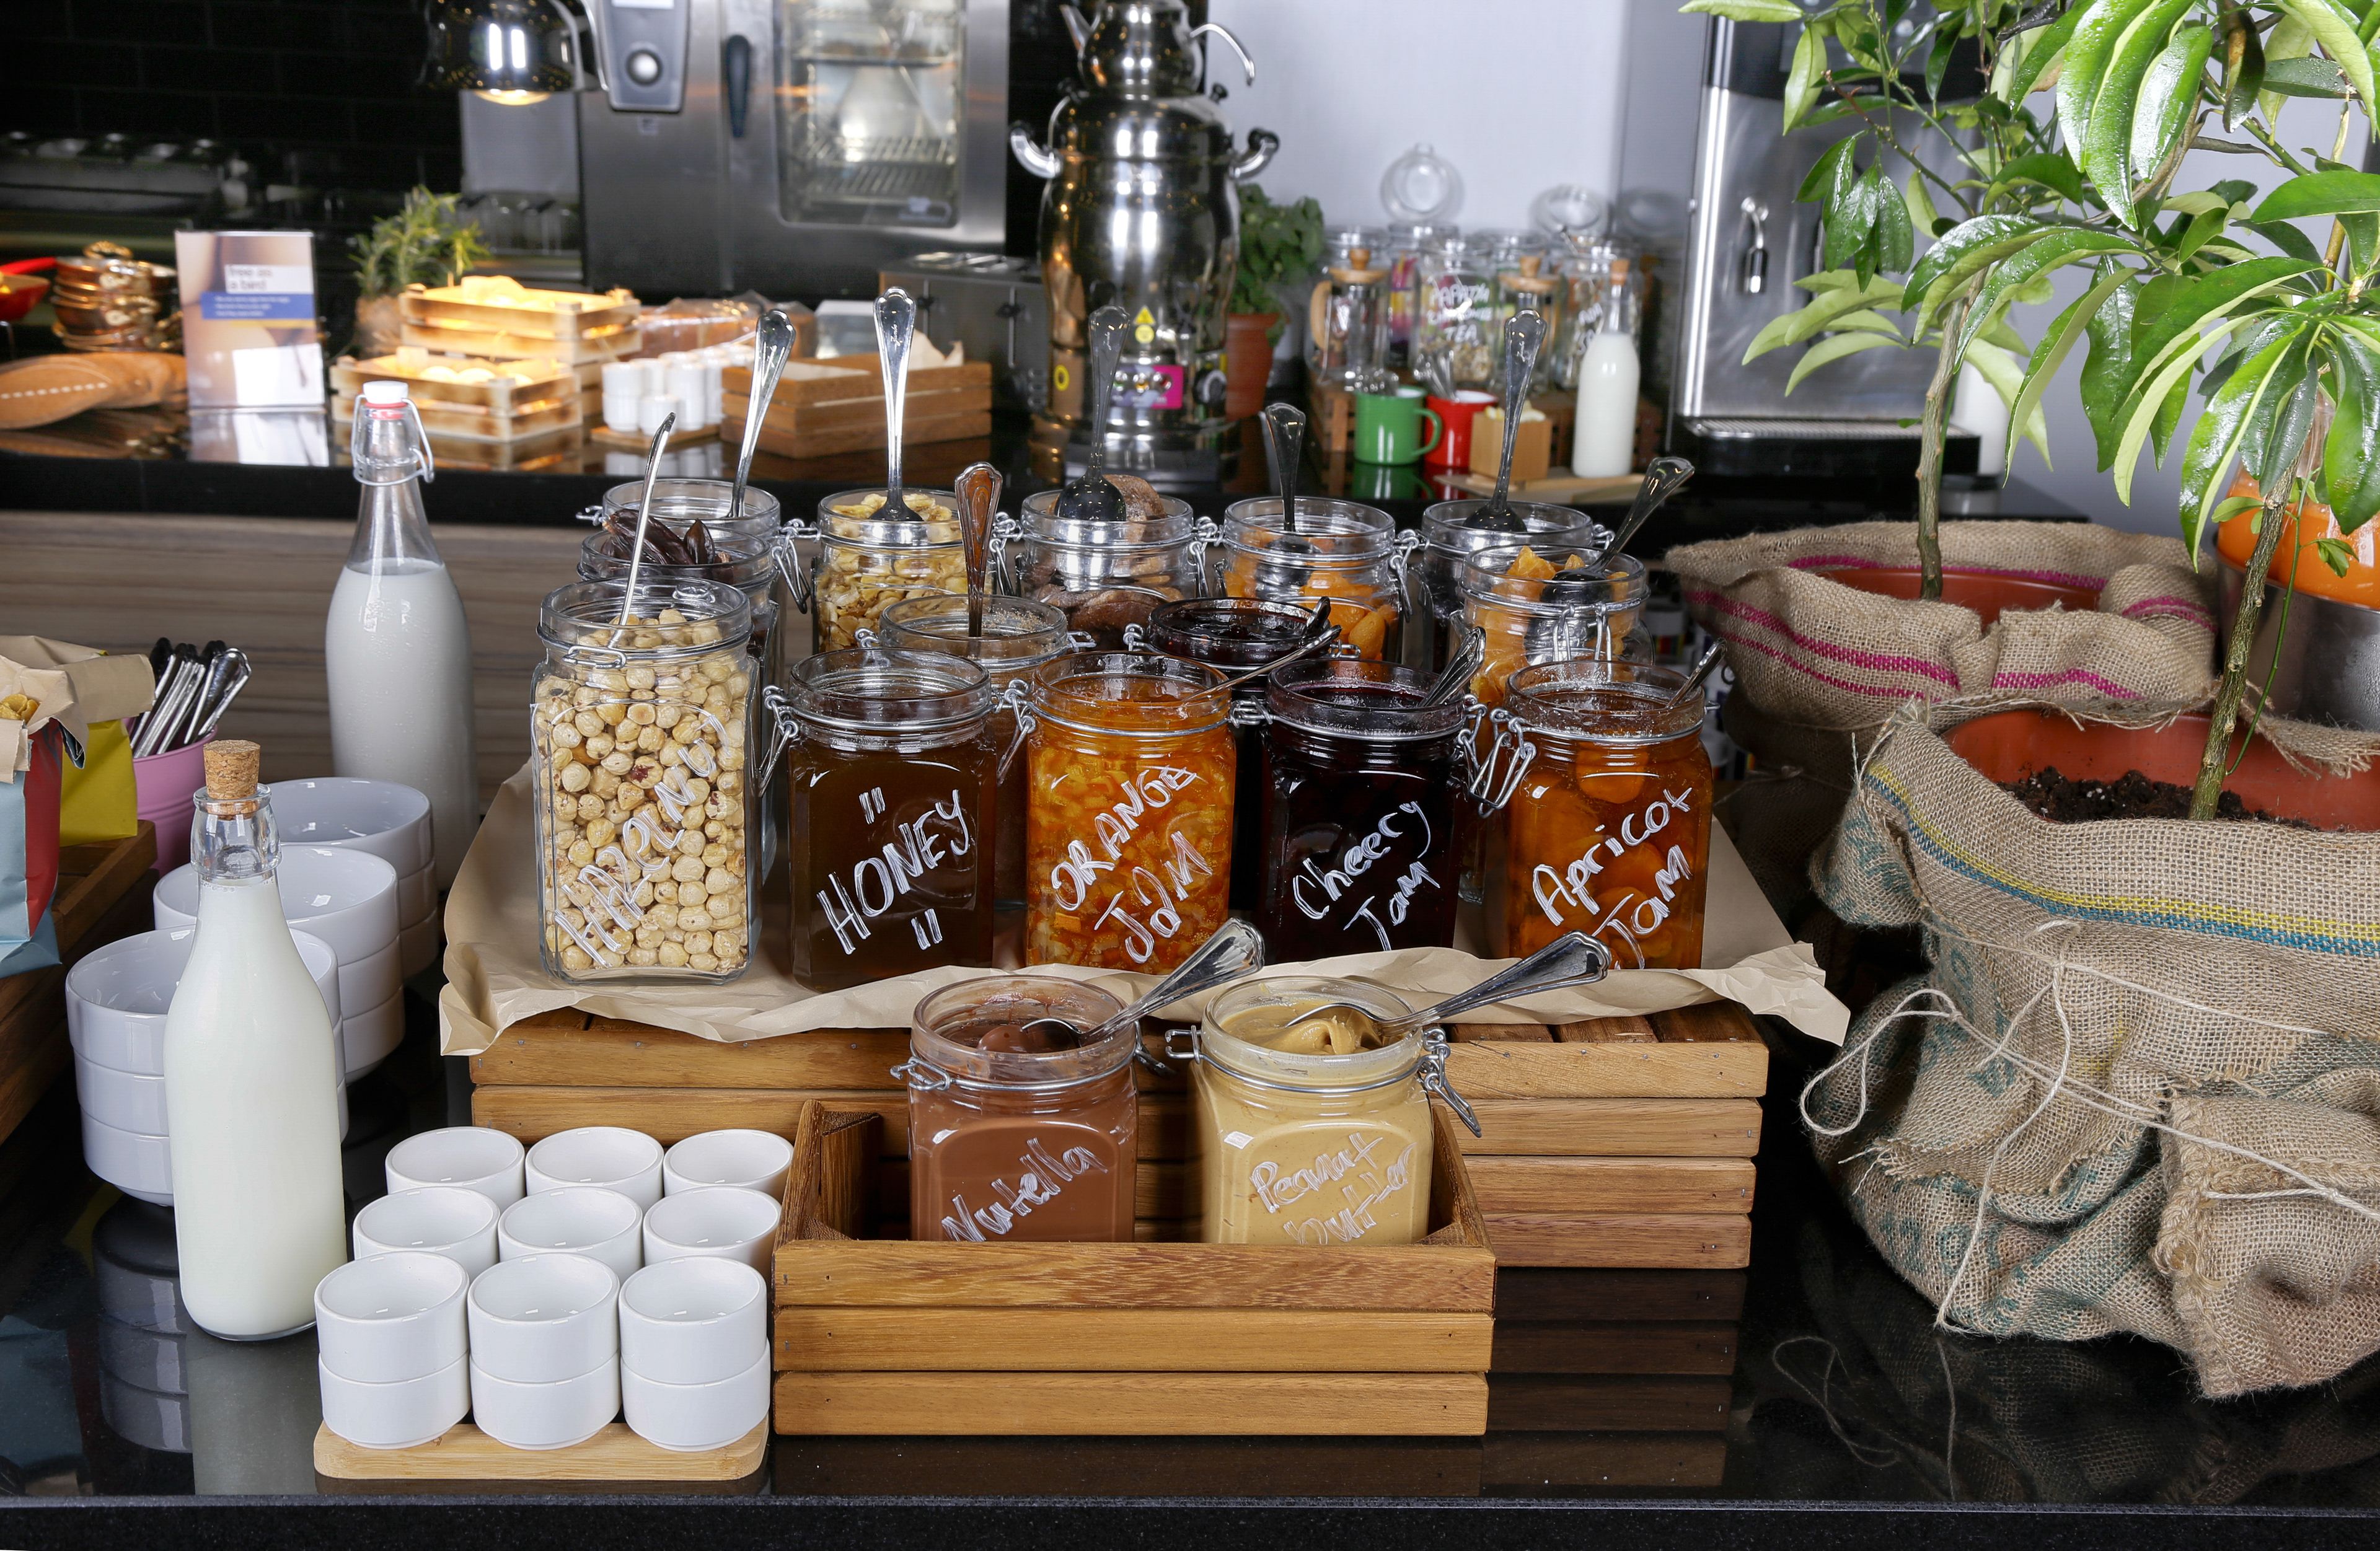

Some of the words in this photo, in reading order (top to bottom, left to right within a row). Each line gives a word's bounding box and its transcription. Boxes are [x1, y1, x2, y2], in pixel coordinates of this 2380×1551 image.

[1443, 324, 1480, 347] TEA
[816, 789, 970, 955] HONEY
[1051, 765, 1200, 911] ORANGE
[1533, 788, 1693, 926] Apricot
[941, 1137, 1109, 1242] Nutella
[1250, 1133, 1383, 1214] Peanut
